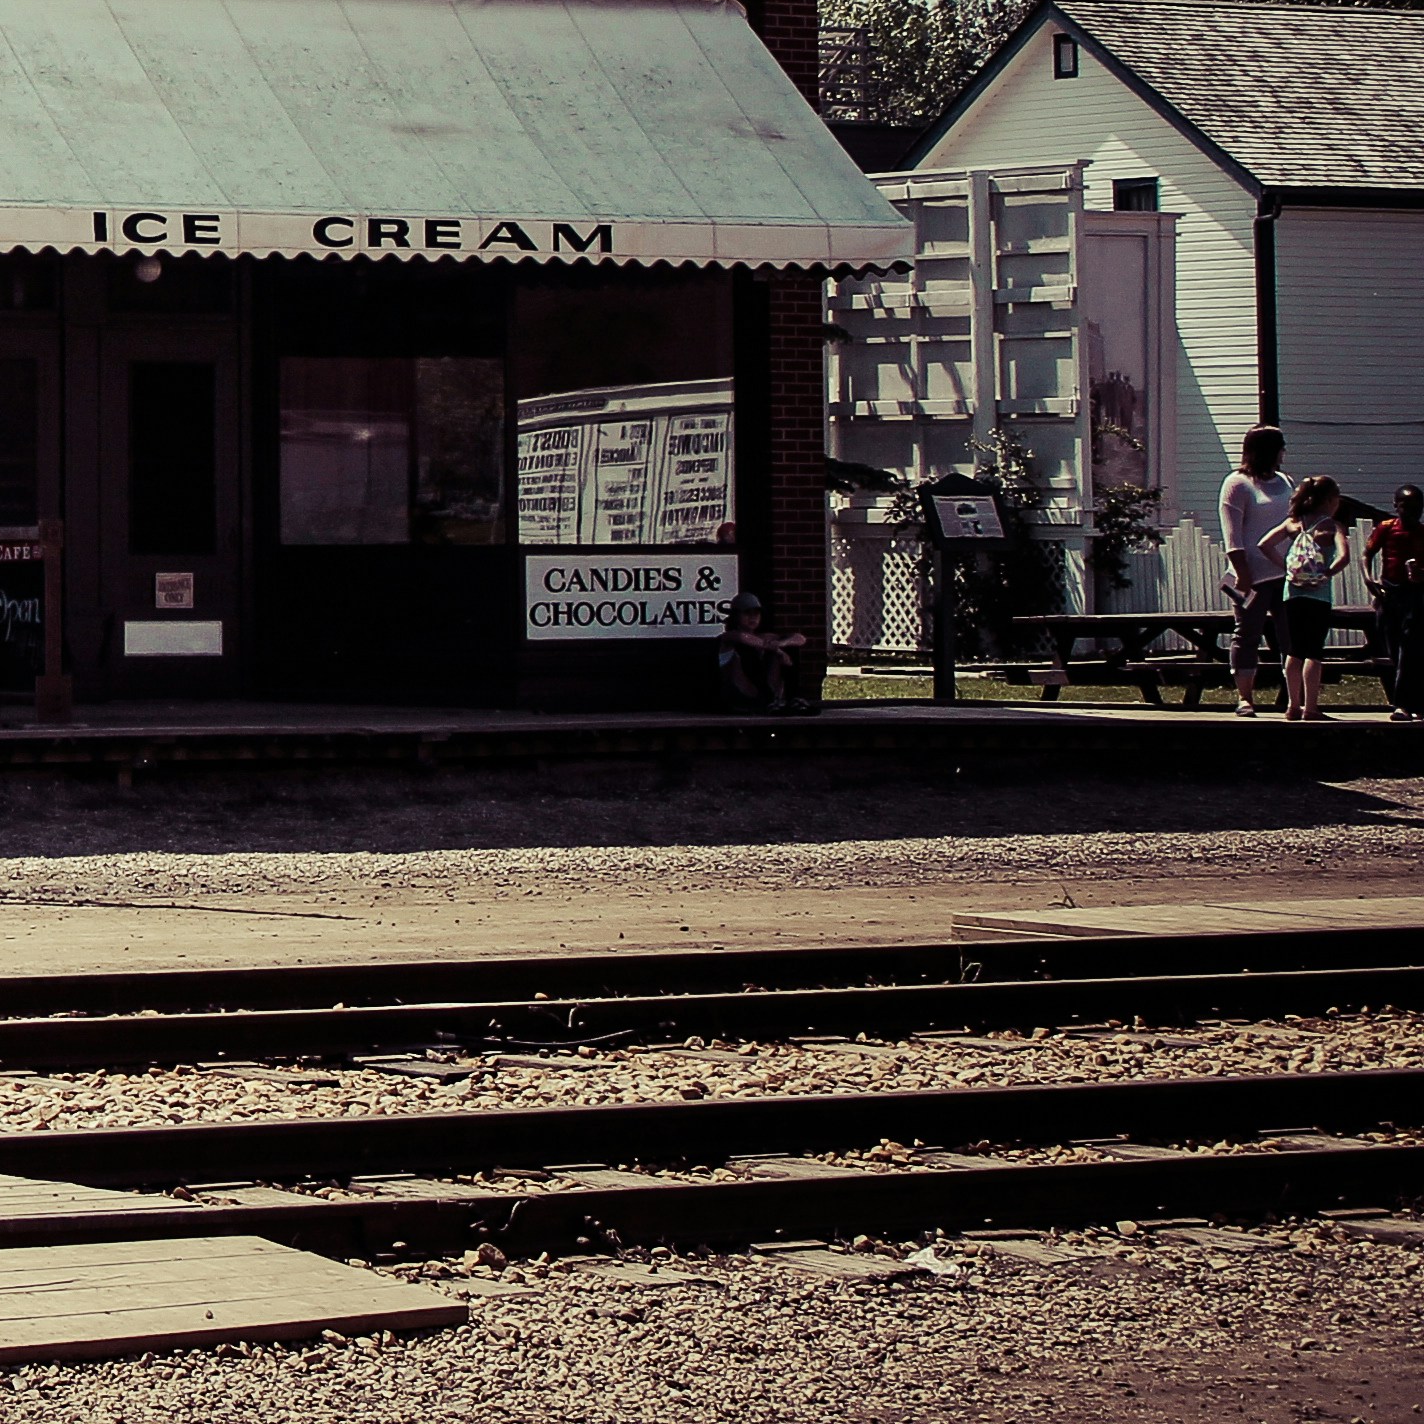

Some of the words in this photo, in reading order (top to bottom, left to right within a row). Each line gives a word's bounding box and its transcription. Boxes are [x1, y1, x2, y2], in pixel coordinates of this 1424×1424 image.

[93, 211, 223, 245] ICE
[312, 215, 616, 254] CREAM
[543, 567, 683, 594] CANDIES
[695, 566, 721, 592] &
[529, 600, 733, 629] CHOCOLATES
